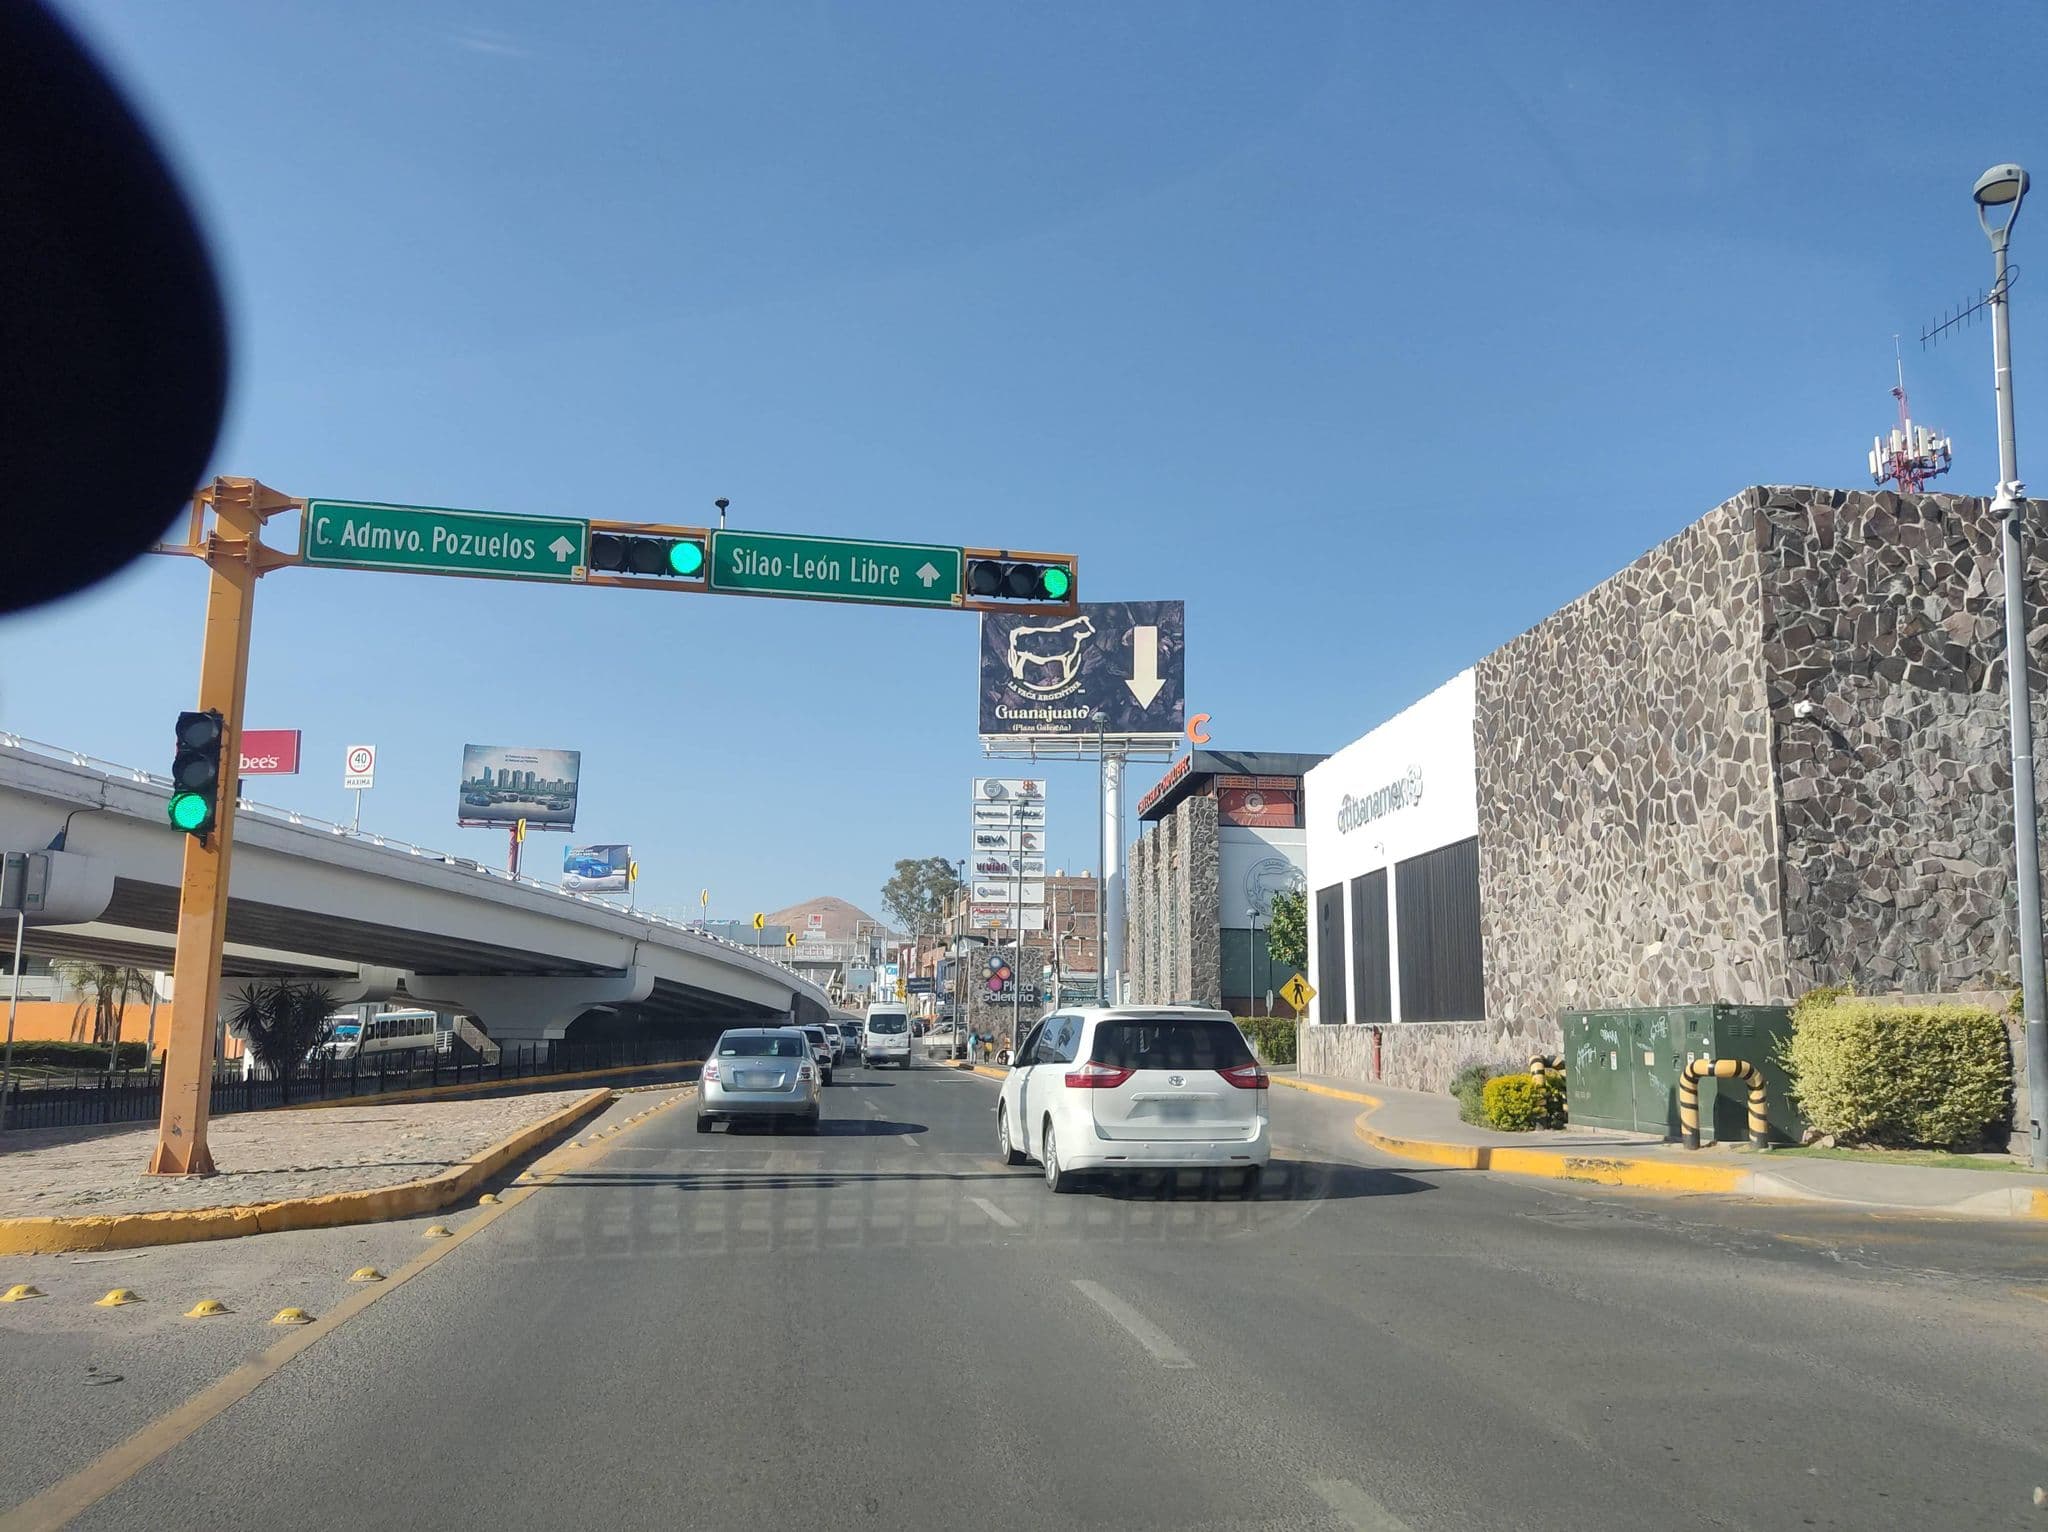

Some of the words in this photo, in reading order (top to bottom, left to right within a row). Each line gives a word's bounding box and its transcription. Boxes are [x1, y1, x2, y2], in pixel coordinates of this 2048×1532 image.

[316, 517, 333, 545] C.
[341, 519, 424, 553] Admvo.
[432, 527, 536, 560] Pozuelos
[732, 547, 840, 580] Silao-León
[851, 557, 900, 586] Libre
[995, 704, 1090, 722] Guanajuato
[1187, 713, 1213, 745] C
[355, 753, 367, 764] 40
[1337, 779, 1409, 835] citibanamex
[977, 835, 1006, 844] BBVA
